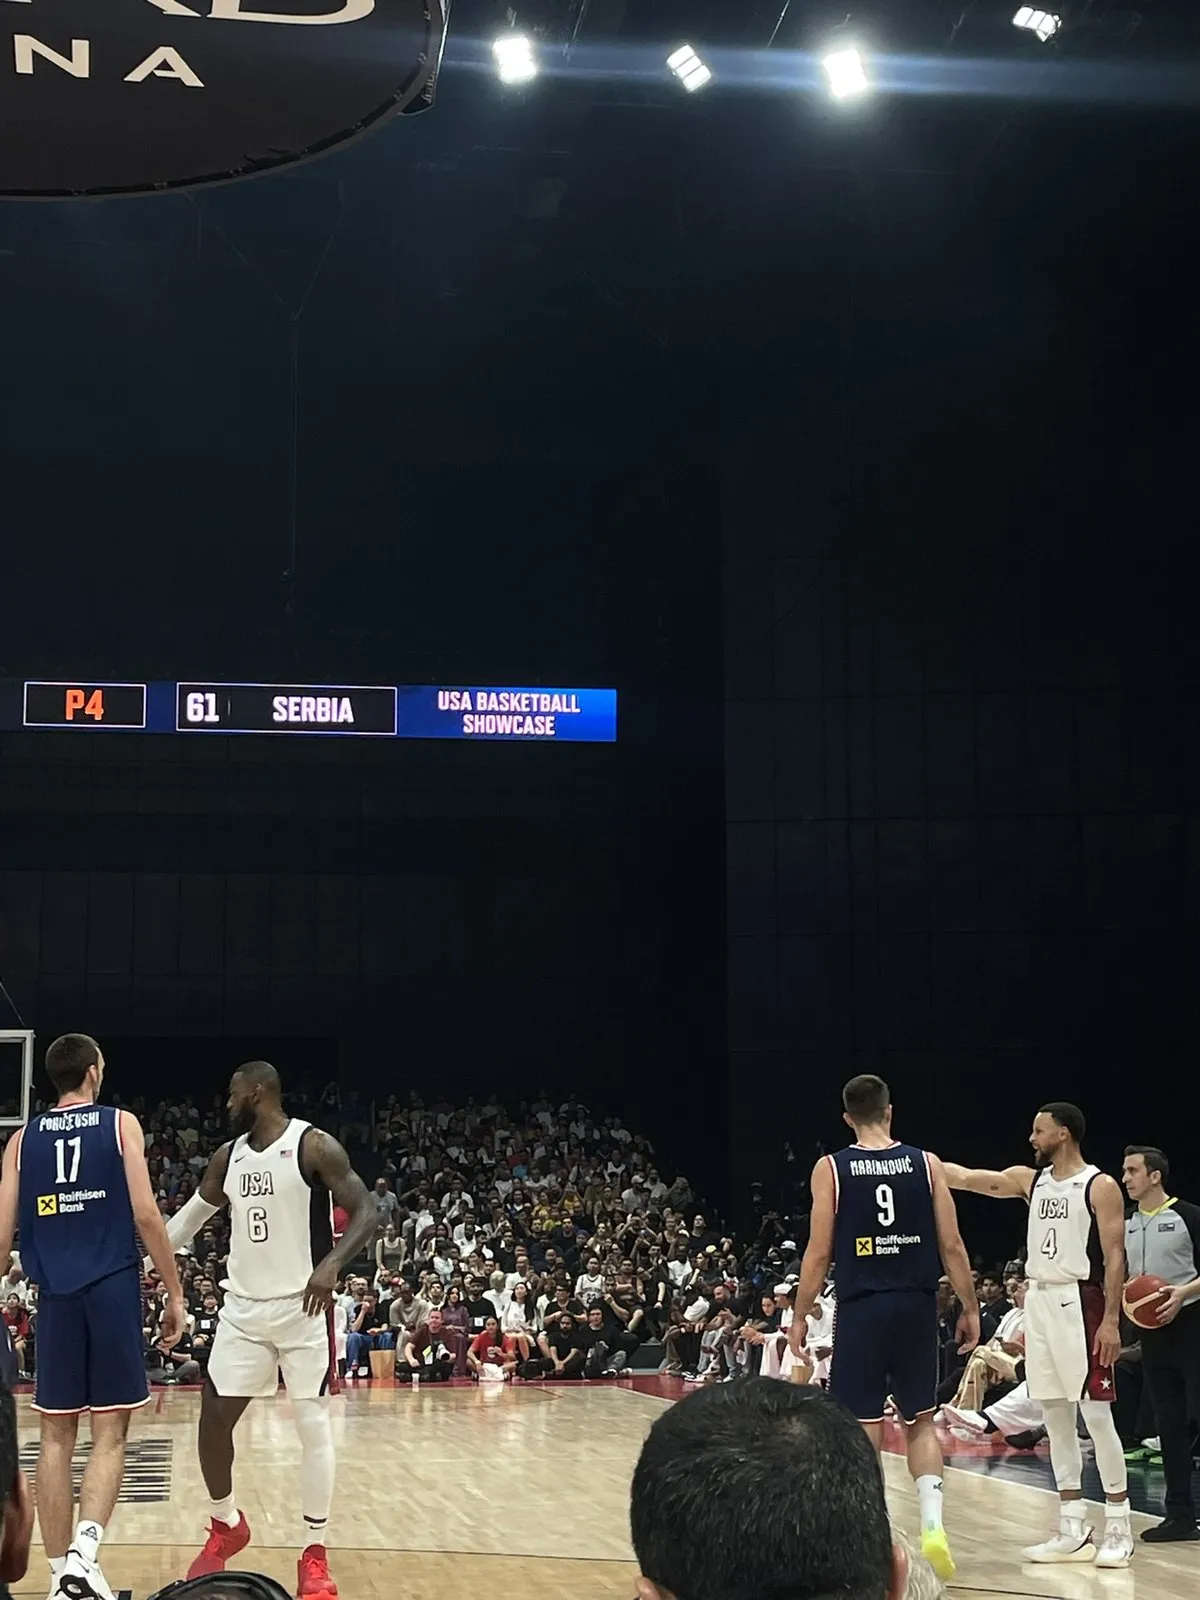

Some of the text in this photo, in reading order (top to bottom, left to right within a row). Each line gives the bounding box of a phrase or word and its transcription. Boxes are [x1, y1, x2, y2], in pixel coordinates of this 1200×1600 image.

[65, 689, 104, 721] P4
[186, 692, 220, 722] 61
[272, 696, 354, 724] SERBIA
[437, 690, 581, 713] USA BASKETBALL
[463, 713, 556, 735] SHOWCASE
[54, 1136, 81, 1184] 17
[240, 1171, 274, 1197] USA
[59, 1202, 85, 1213] Bank
[875, 1183, 895, 1227] 9
[1038, 1198, 1068, 1219] USA
[247, 1206, 268, 1243] 6
[875, 1234, 921, 1245] Raiffeisen
[875, 1244, 900, 1255] Bank
[1040, 1228, 1057, 1260] 4
